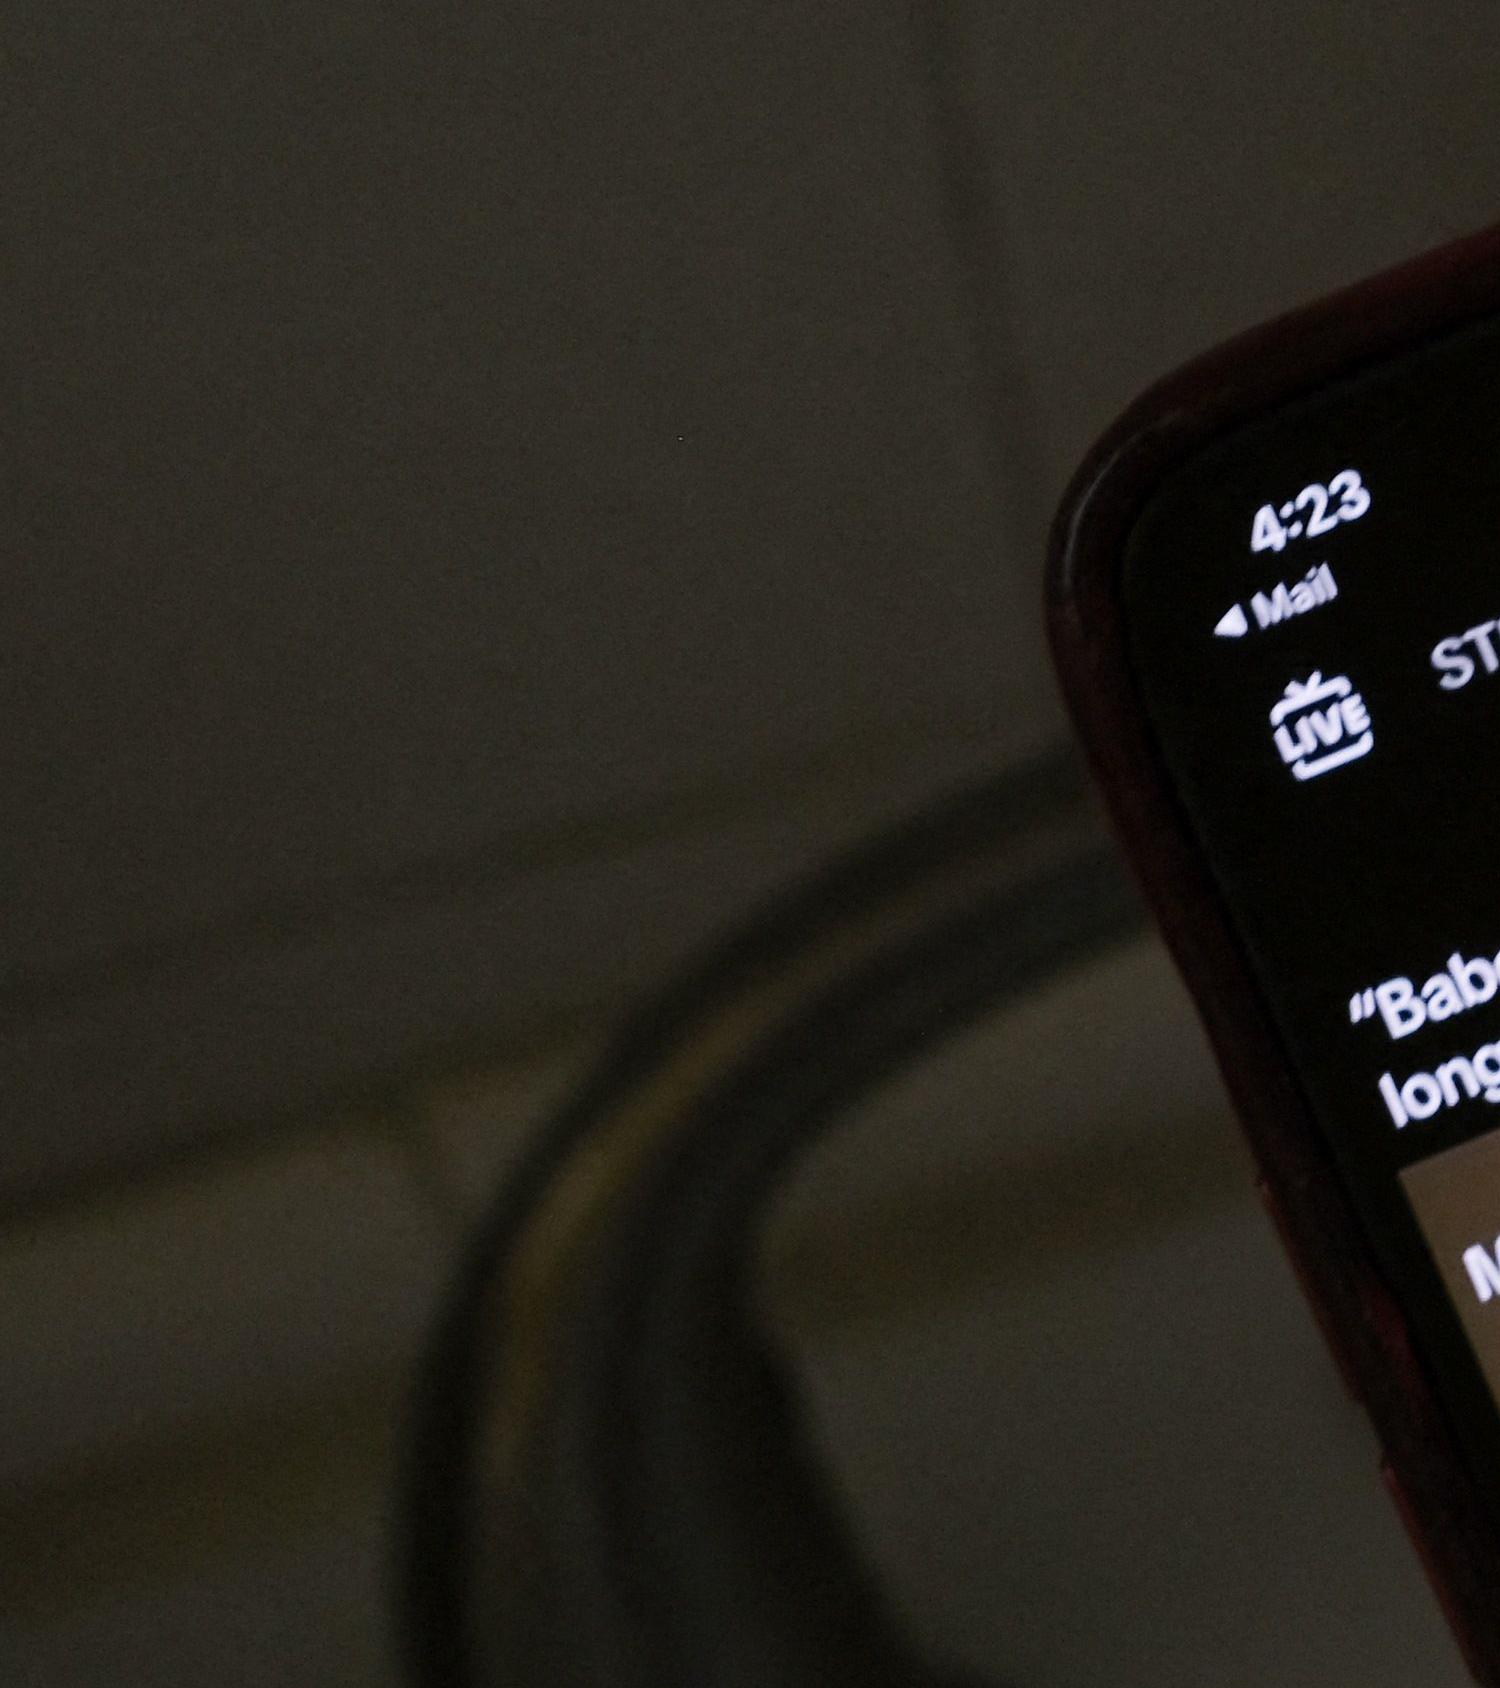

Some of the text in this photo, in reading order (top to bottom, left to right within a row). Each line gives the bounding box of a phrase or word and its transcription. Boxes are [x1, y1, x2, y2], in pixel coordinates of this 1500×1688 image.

[1249, 468, 1372, 554] 4:23
[1249, 561, 1339, 630] Mail
[1272, 693, 1373, 765] LIVE
